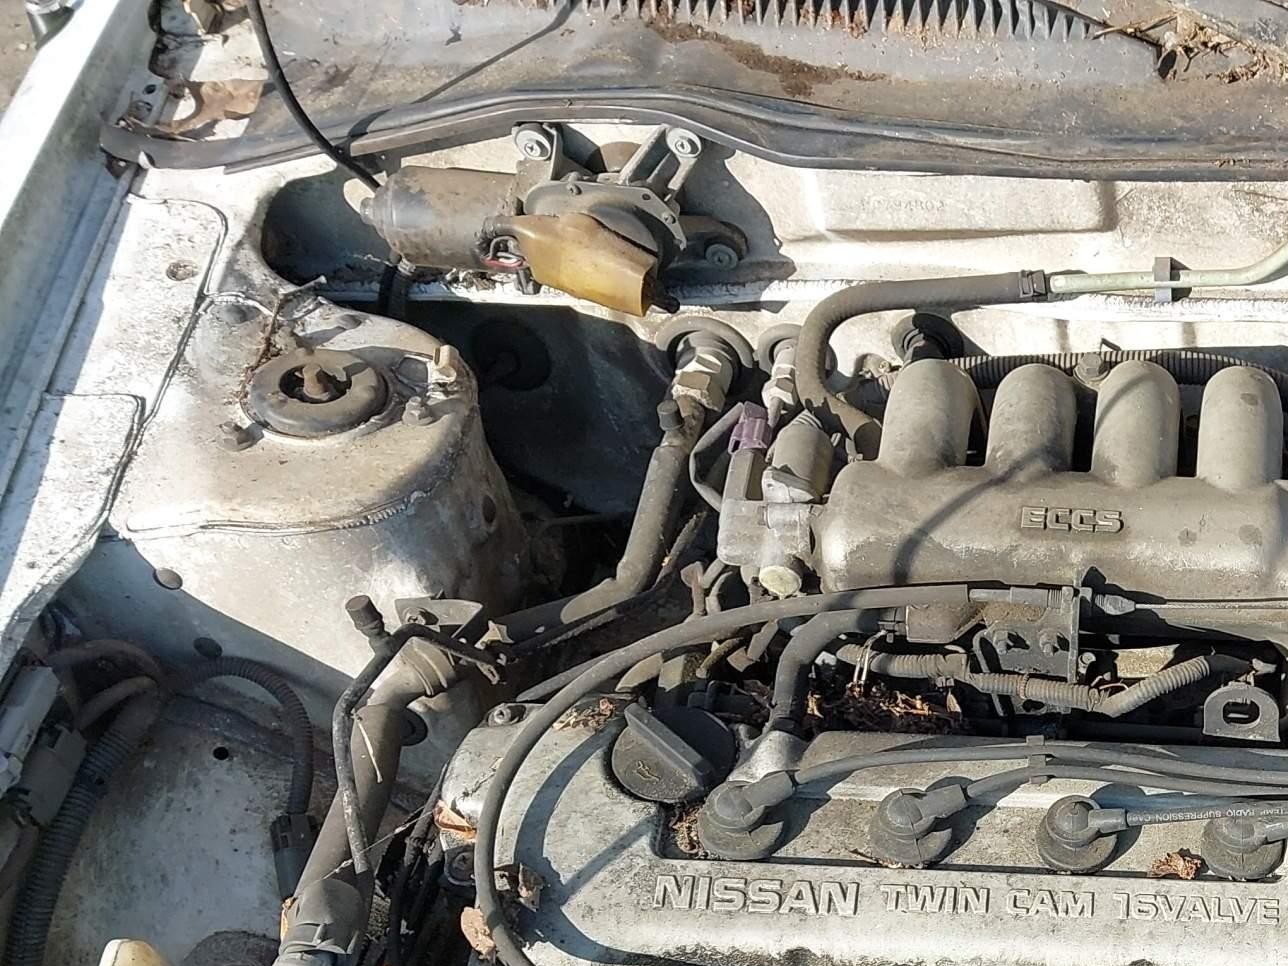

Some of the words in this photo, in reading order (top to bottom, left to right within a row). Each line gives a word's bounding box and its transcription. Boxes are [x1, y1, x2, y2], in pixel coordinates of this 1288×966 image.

[1020, 506, 1125, 534] ECCS
[1155, 810, 1222, 822] SUPPRESSION
[1225, 808, 1255, 817] RADIO
[653, 875, 860, 917] NISSAN
[880, 884, 991, 914] TWIN
[1005, 889, 1097, 920] CAM
[1111, 892, 1281, 926] 16VALVE
